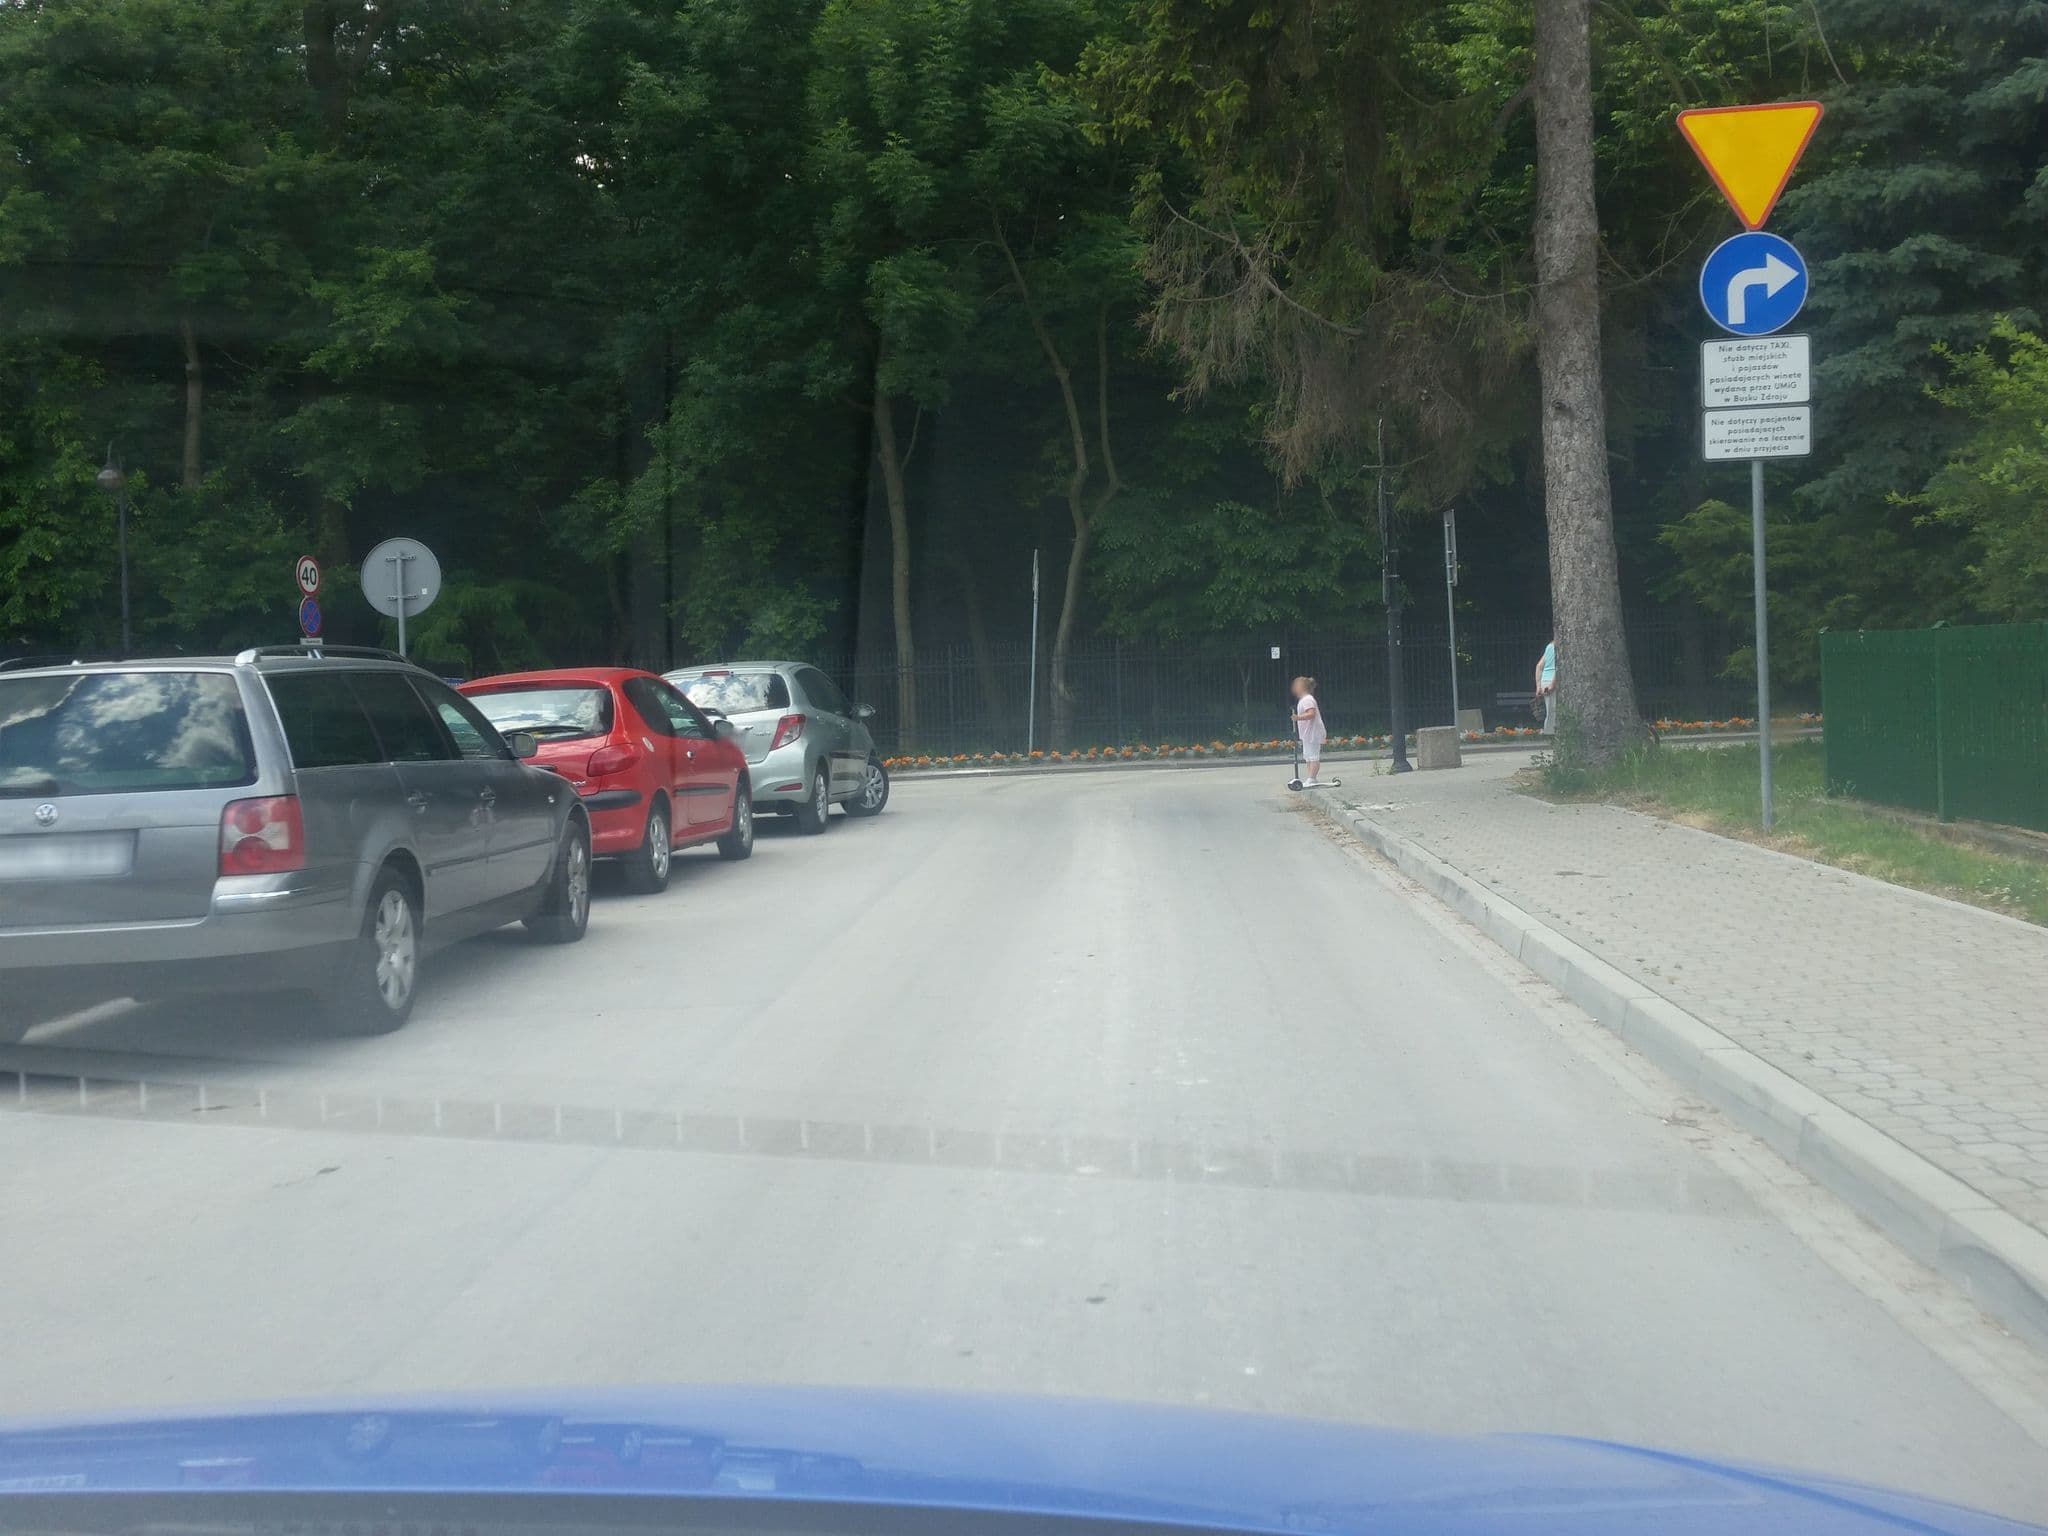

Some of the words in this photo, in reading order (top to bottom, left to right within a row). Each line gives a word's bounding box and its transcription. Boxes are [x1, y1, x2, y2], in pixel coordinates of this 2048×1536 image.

[1736, 344, 1767, 352] dotyczy
[1748, 352, 1788, 362] miejskich
[1733, 394, 1758, 402] Busku
[1760, 392, 1788, 401] Zdroju
[1727, 417, 1757, 426] dotyczy
[1772, 433, 1805, 442] leczenie
[302, 566, 317, 586] 40
